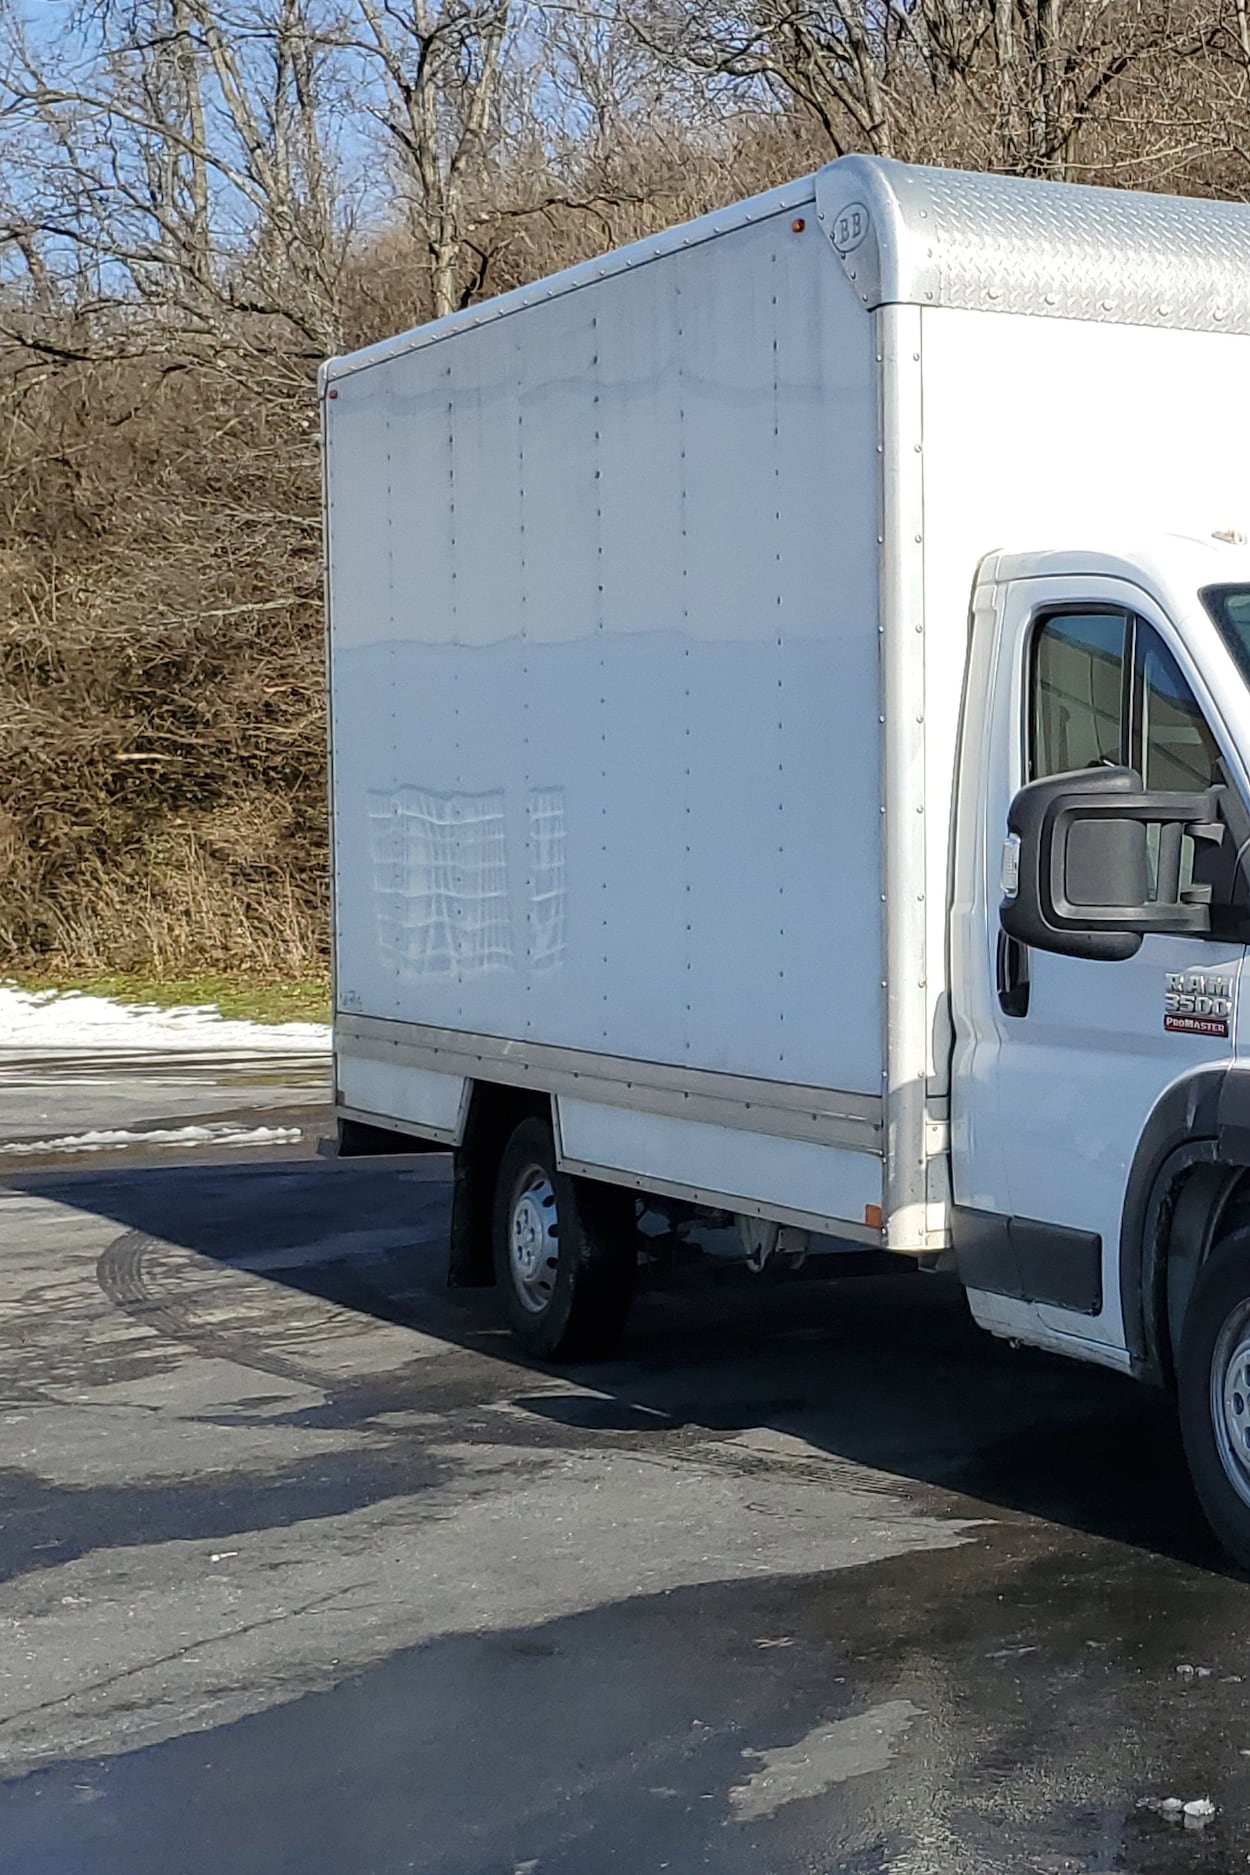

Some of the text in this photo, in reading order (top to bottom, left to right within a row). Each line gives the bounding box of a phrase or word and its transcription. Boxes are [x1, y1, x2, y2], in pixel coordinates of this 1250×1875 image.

[839, 212, 862, 244] BB
[1165, 973, 1233, 997] RAM
[1165, 993, 1232, 1017] 3500
